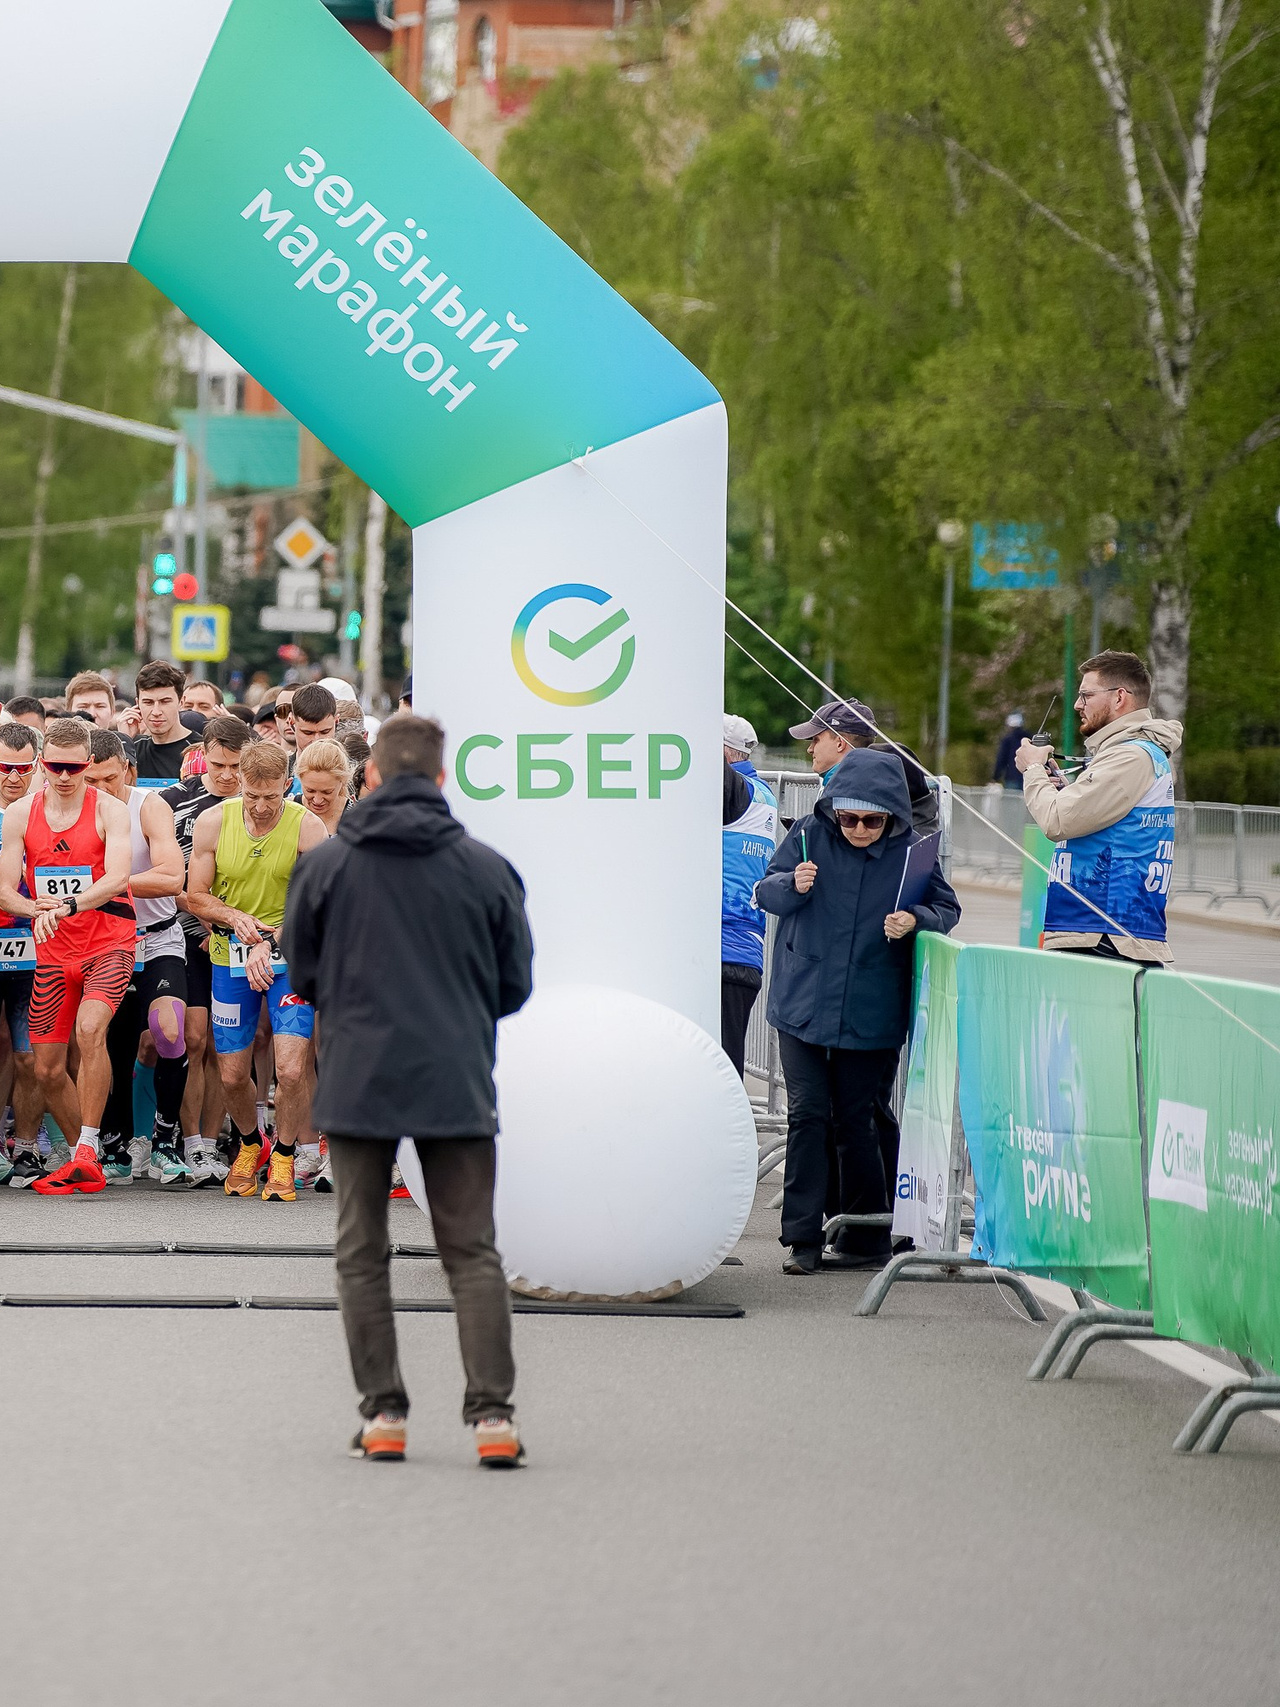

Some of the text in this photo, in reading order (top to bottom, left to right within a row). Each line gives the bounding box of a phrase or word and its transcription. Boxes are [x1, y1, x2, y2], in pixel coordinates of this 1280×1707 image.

[240, 187, 477, 413] марафон
[283, 146, 529, 371] зелёный
[455, 733, 691, 801] СБЕР
[47, 879, 83, 895] 812
